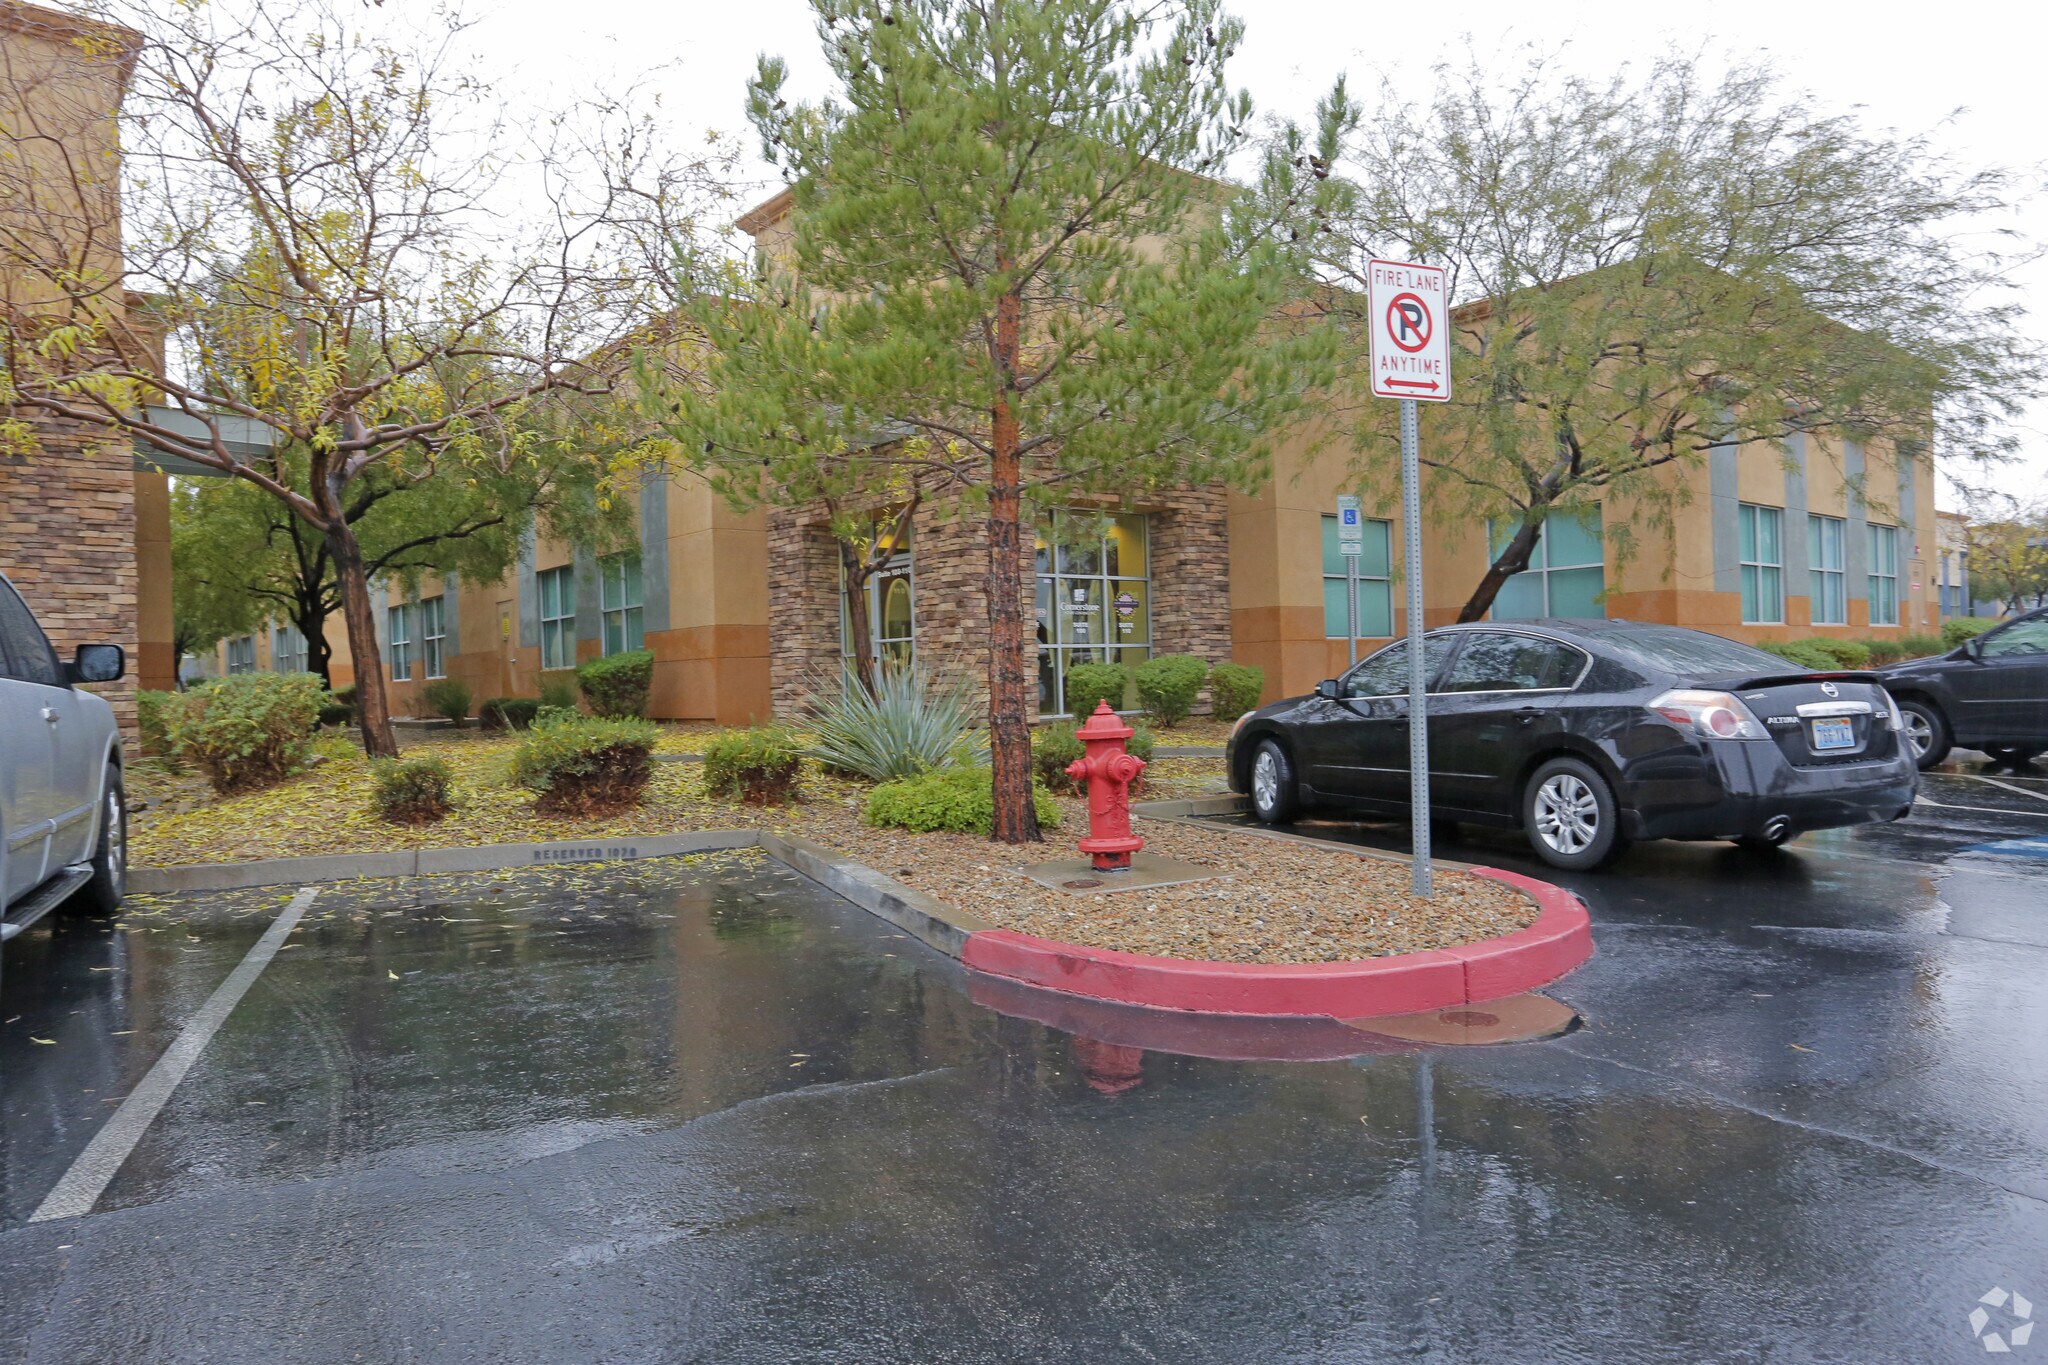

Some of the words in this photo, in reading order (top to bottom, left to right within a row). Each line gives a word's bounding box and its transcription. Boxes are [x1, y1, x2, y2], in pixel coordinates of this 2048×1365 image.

[1375, 269, 1403, 287] FIRE
[1407, 272, 1440, 292] LANE
[1380, 355, 1441, 375] ANYTIME
[877, 570, 891, 578] Suite
[1060, 602, 1100, 612] Cornerstone
[1767, 716, 1801, 725] ALTIMA
[533, 848, 603, 860] RESERVED
